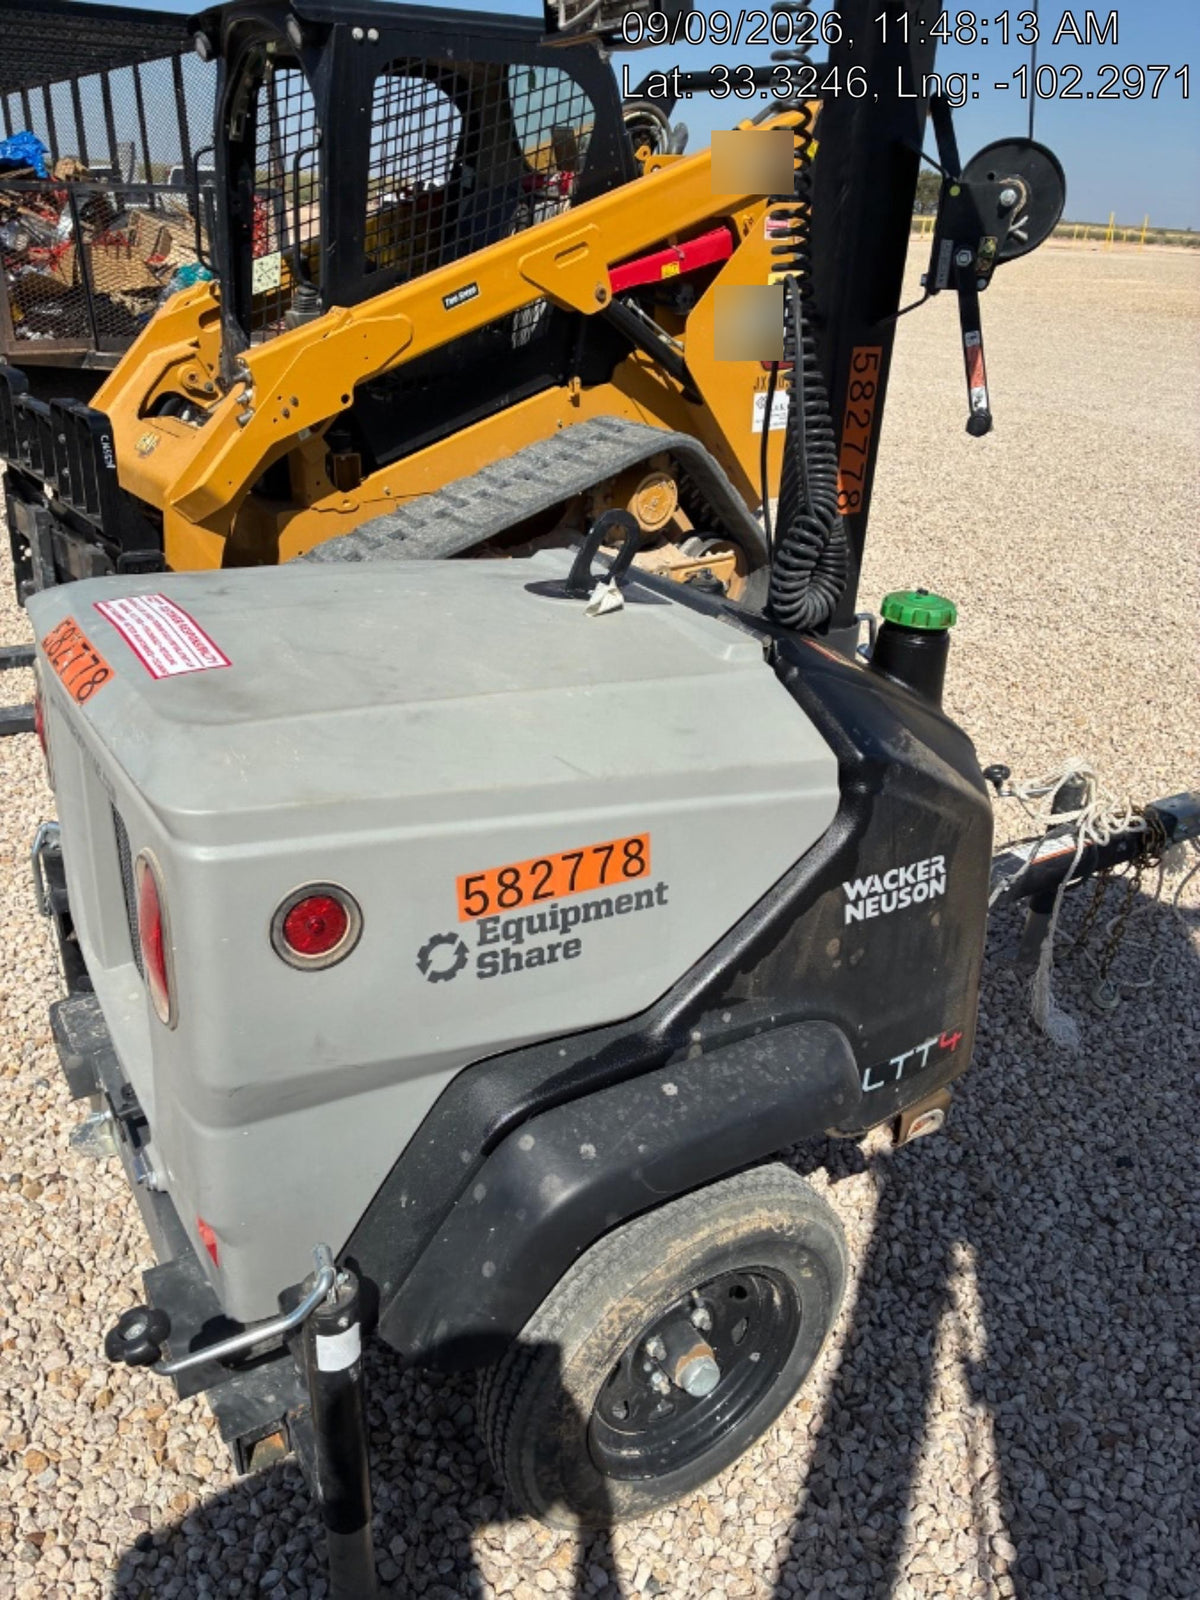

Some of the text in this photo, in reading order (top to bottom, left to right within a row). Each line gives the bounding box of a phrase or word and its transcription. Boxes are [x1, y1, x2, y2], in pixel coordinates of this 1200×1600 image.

[837, 352, 880, 510] 582778
[43, 620, 109, 701] 582778
[463, 838, 646, 917] 582778
[842, 855, 947, 901] WACKER
[845, 874, 947, 925] NEUSON
[476, 882, 669, 946] Equipment
[476, 938, 582, 980] Share
